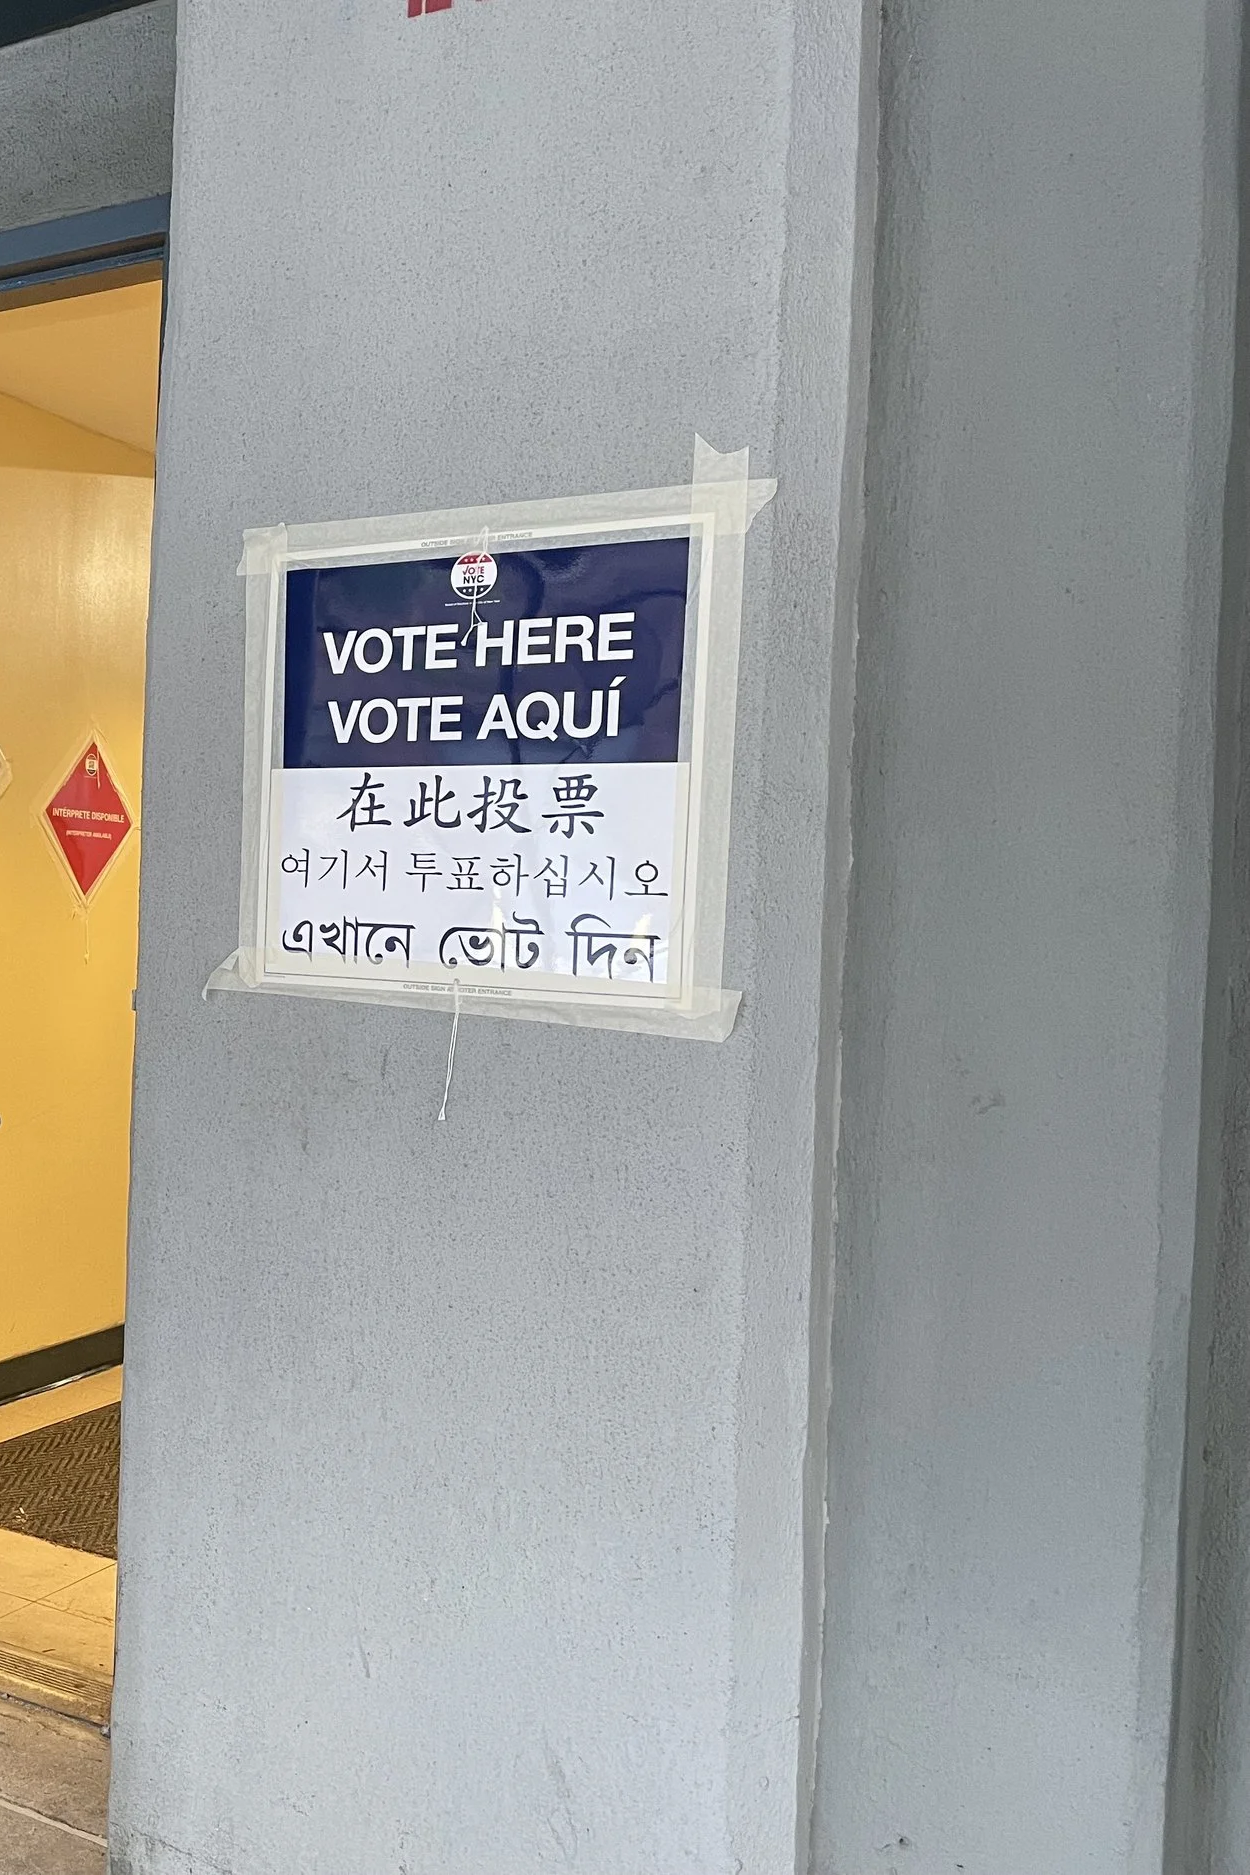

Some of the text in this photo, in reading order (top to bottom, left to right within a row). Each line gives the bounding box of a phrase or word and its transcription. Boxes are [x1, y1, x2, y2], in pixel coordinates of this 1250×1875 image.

[497, 532, 533, 542] ENTRANCE
[463, 574, 485, 584] NYC
[322, 612, 635, 674] VOTE HERE
[328, 676, 627, 744] VOTE AQUÍ
[336, 772, 605, 839] 在此投票
[281, 847, 669, 900] 여기서 투표하십시오
[282, 911, 661, 983] এখানে ভোট দিন
[478, 988, 512, 996] ENTRANCE
